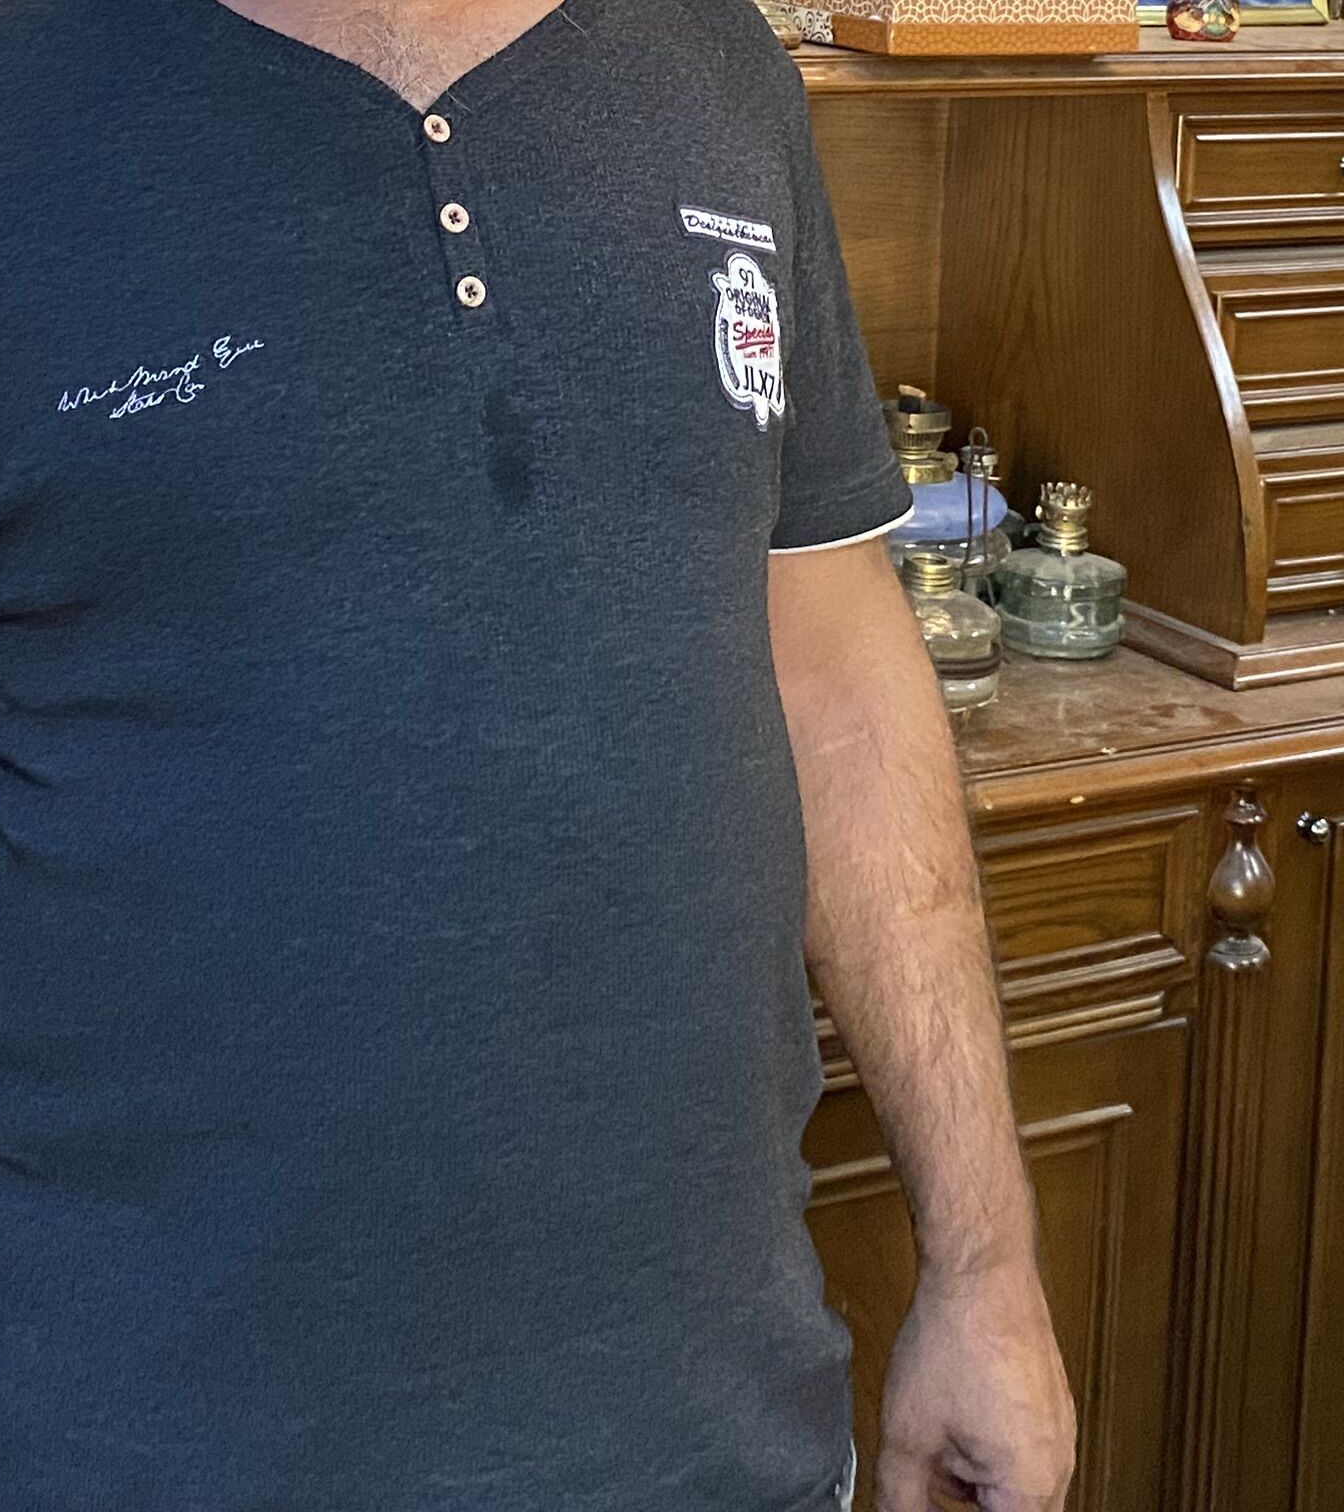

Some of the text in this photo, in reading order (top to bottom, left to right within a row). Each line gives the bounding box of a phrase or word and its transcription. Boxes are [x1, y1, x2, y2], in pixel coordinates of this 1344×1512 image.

[739, 267, 755, 289] 97
[733, 320, 774, 344] Special
[743, 364, 775, 401] JLX7
